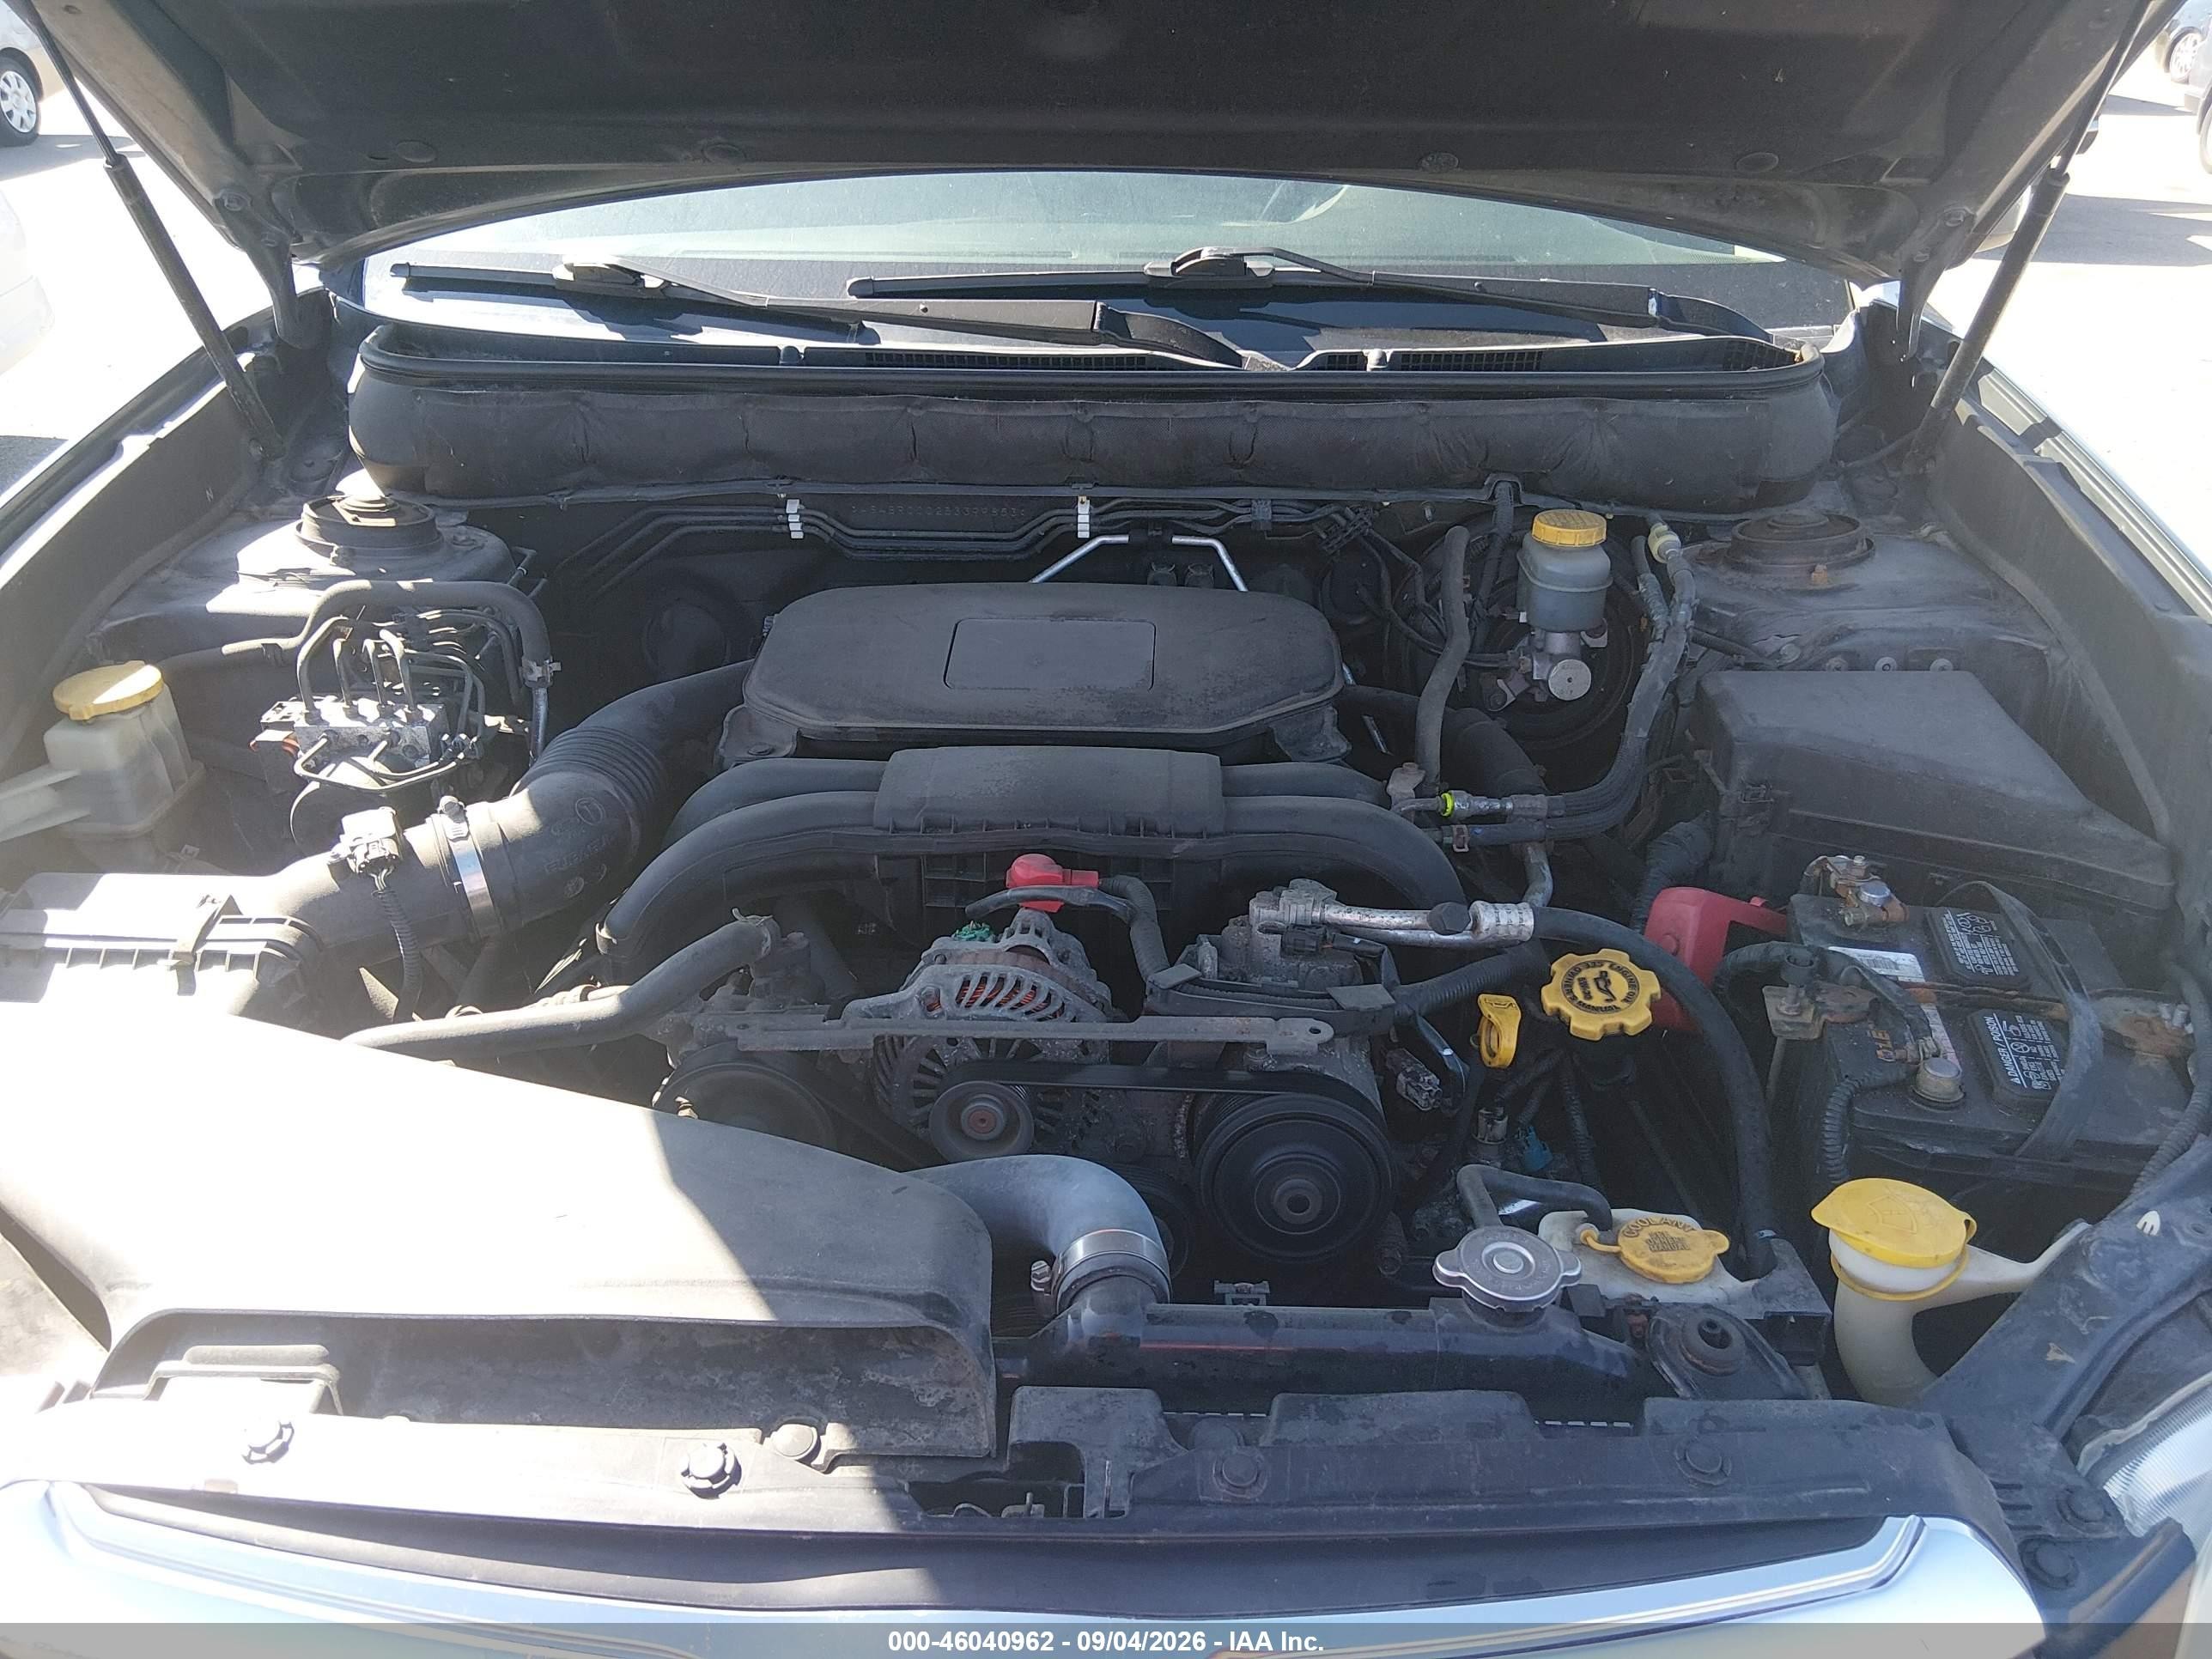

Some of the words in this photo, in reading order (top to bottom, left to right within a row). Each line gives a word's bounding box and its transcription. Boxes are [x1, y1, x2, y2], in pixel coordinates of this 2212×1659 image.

[1983, 1016, 2004, 1042] POISON
[1997, 1048, 2019, 1078] DANGER
[1623, 1217, 1697, 1237] COOLANT
